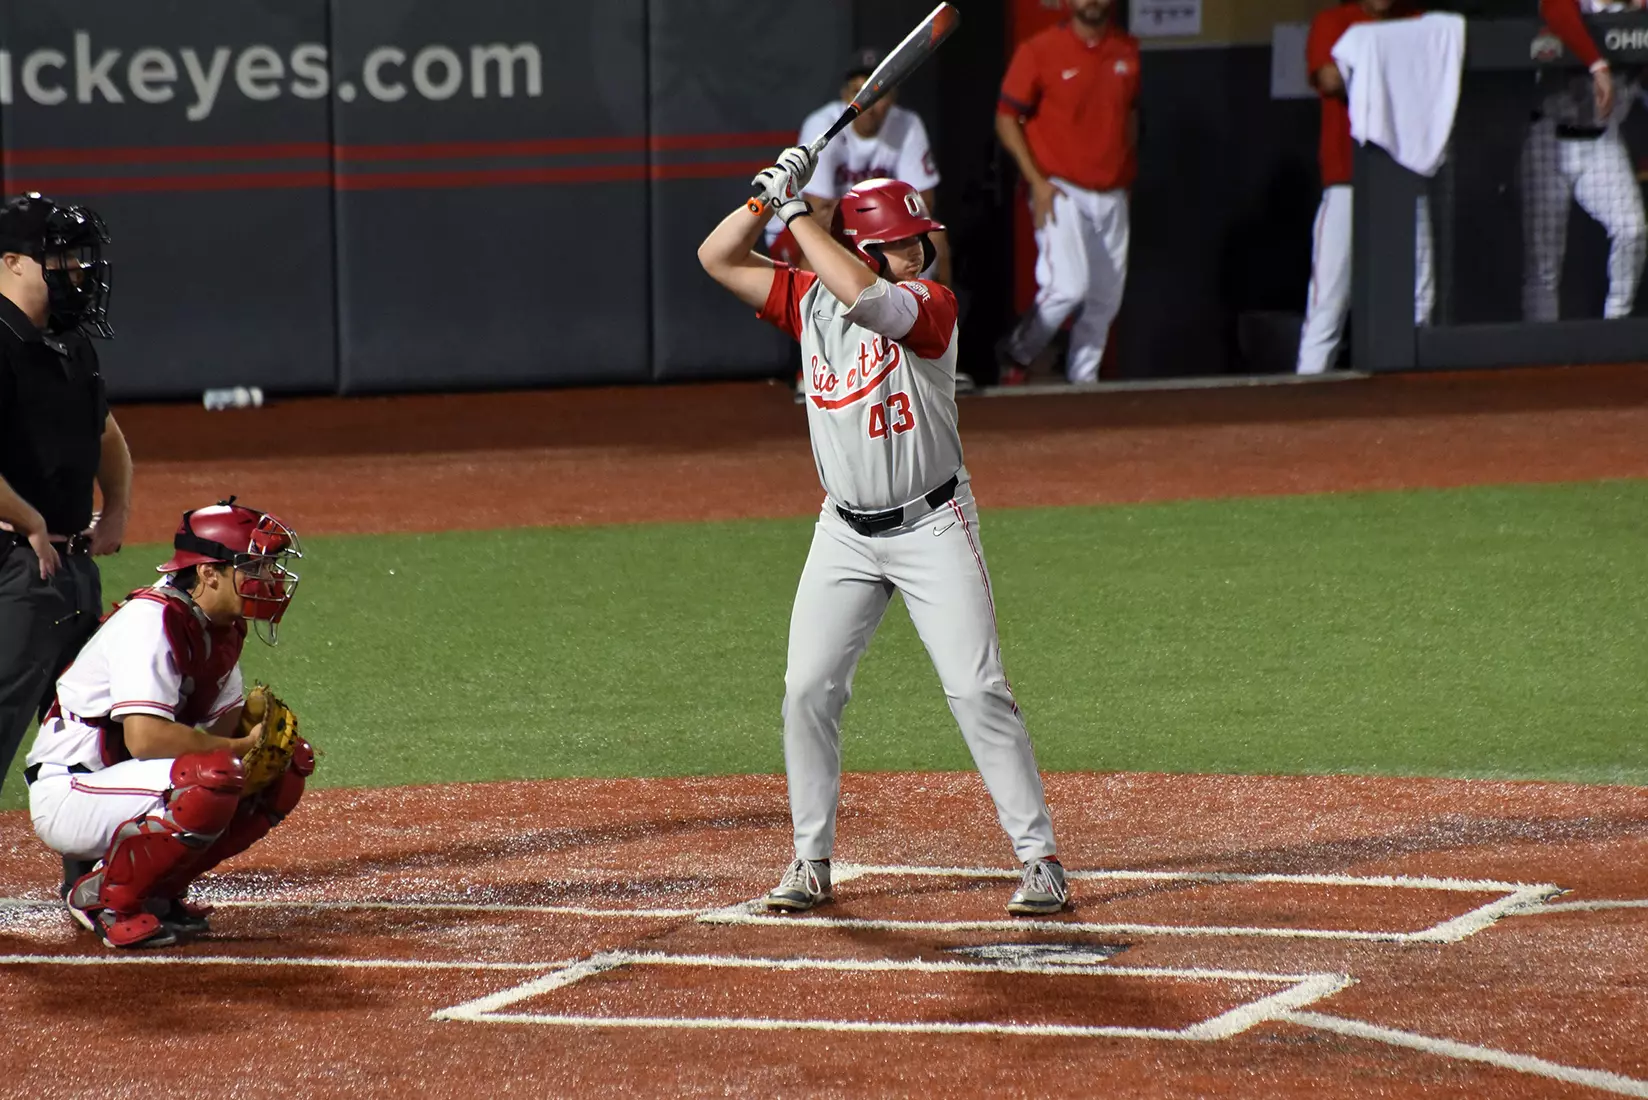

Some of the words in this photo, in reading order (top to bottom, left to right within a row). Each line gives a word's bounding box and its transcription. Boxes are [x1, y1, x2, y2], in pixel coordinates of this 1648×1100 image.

[1605, 29, 1648, 50] OHI
[0, 29, 543, 121] ckeyes.com
[867, 391, 916, 440] 43
